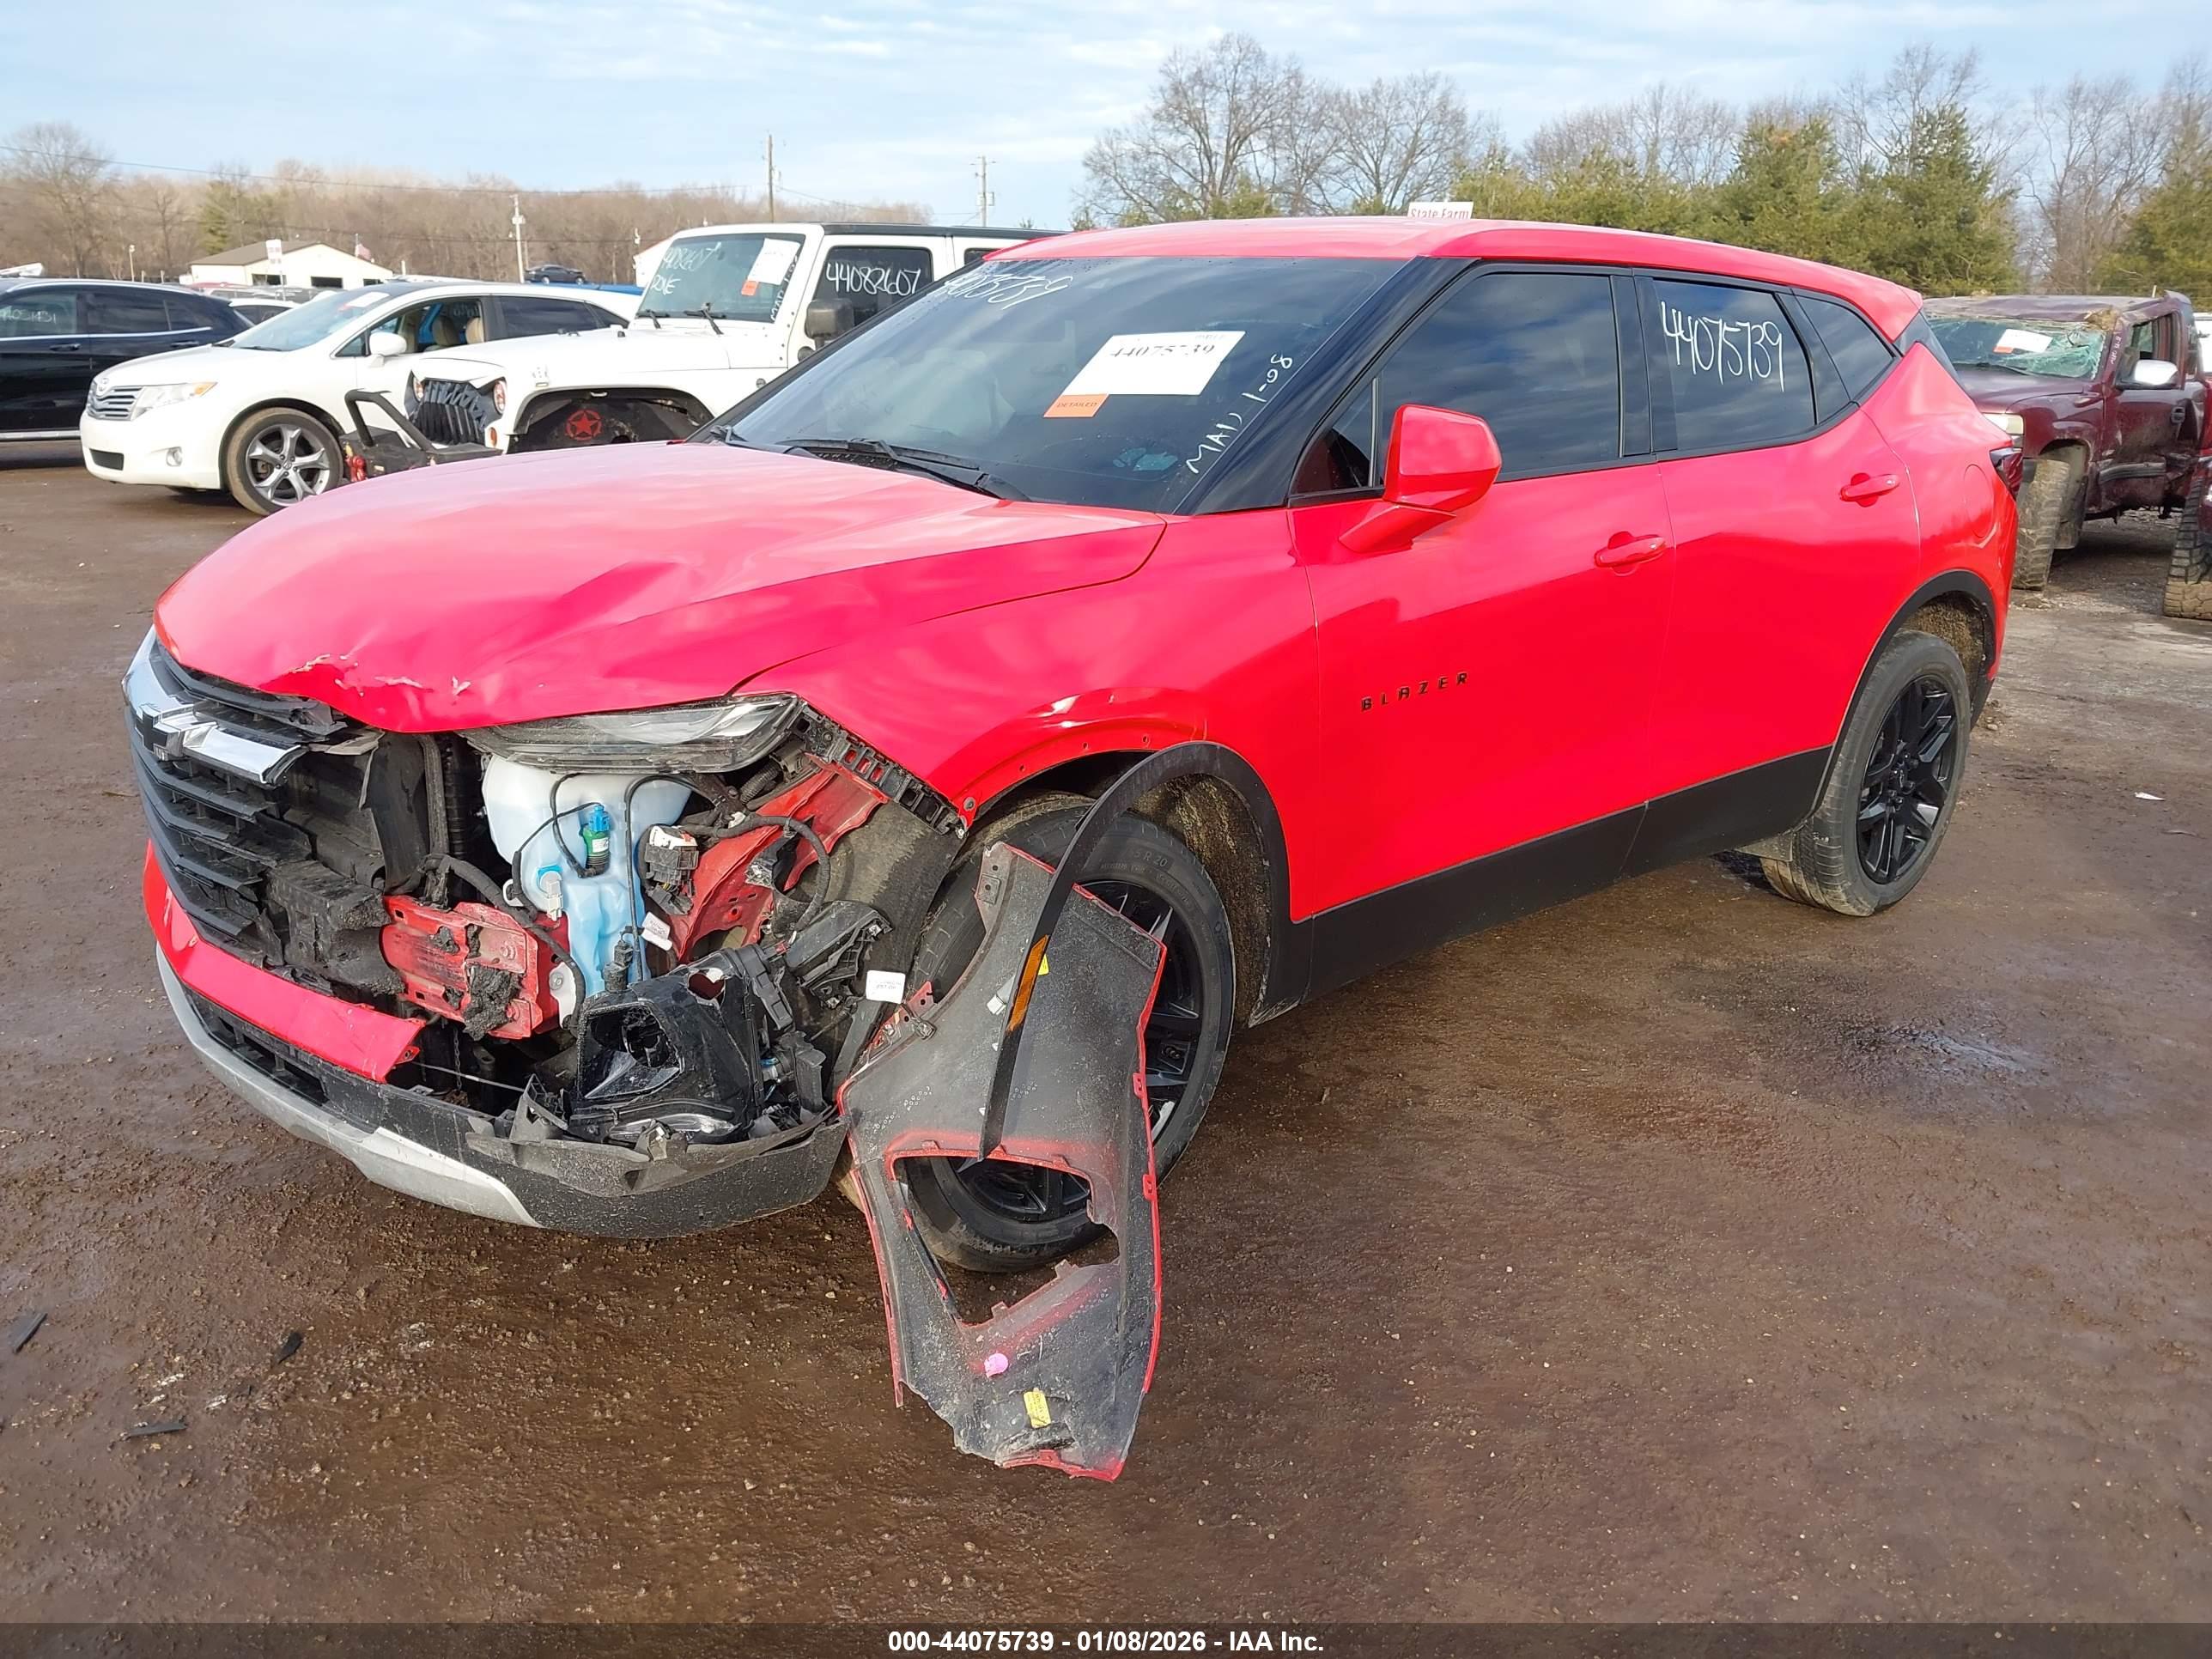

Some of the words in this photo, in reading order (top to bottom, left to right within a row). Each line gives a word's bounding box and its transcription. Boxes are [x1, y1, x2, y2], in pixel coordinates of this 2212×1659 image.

[825, 261, 921, 296] 44082607
[1661, 301, 1785, 392] 44075739
[1185, 412, 1243, 474] MAD
[1360, 672, 1468, 712] BLAZER
